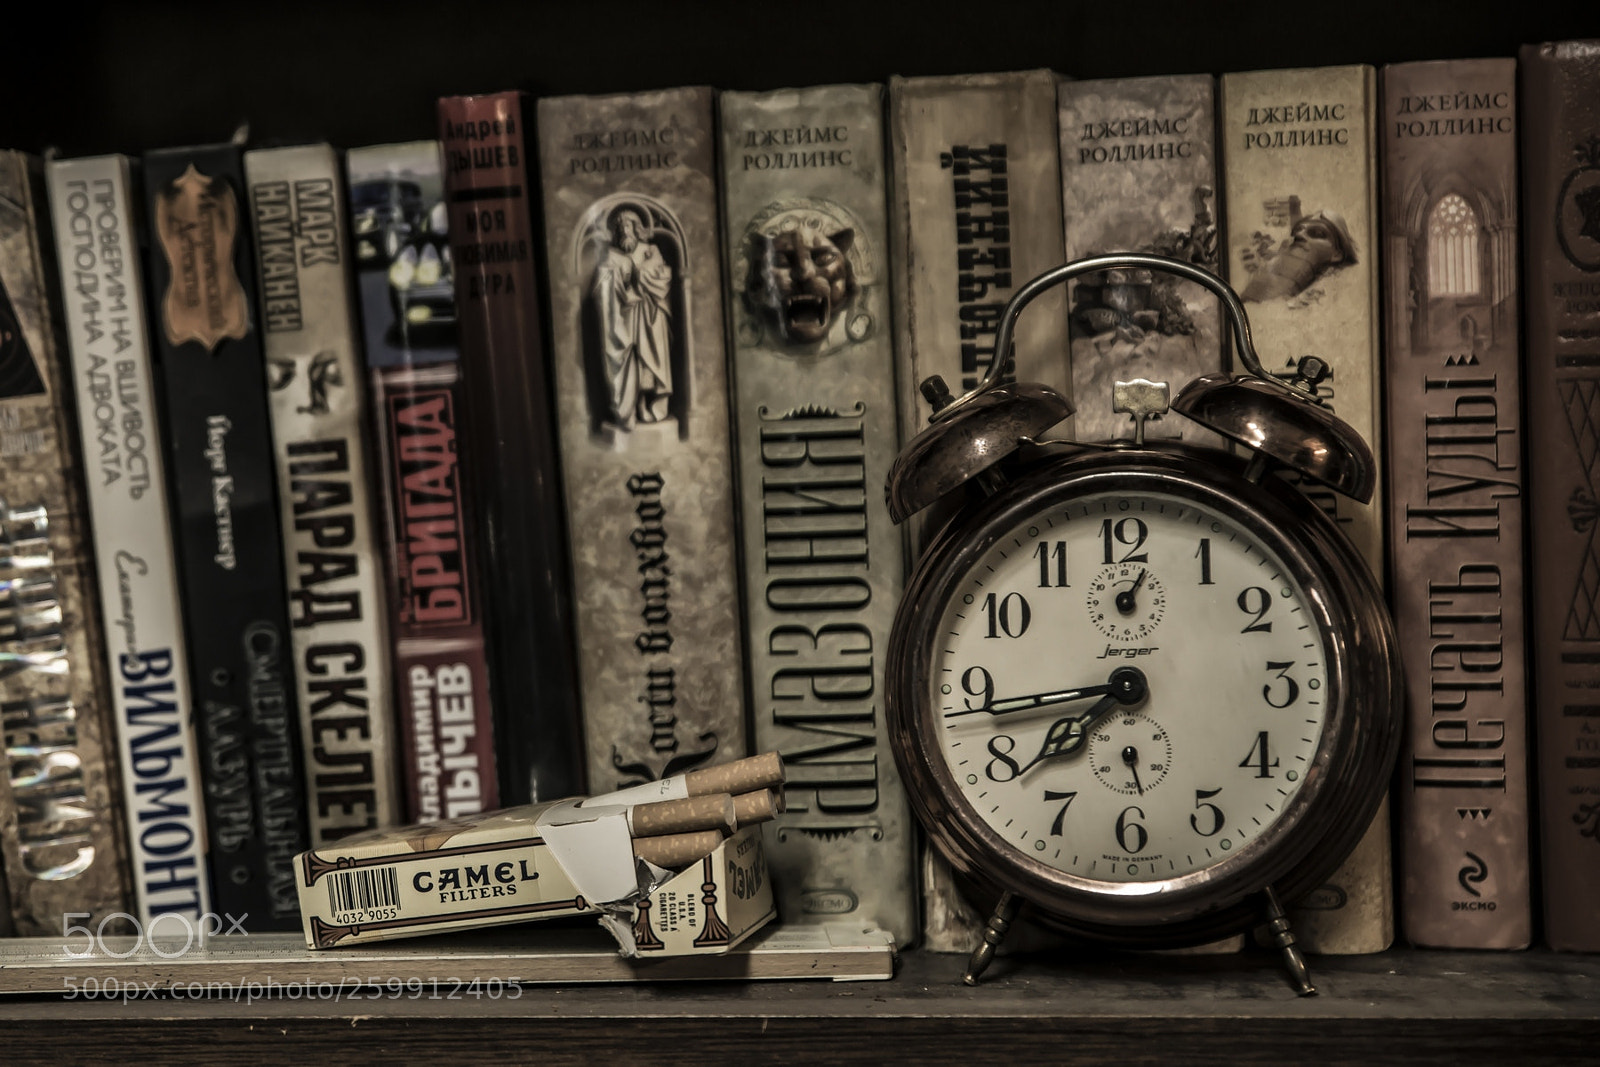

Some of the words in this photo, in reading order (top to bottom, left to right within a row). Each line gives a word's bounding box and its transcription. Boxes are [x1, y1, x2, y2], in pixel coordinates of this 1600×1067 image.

[1246, 104, 1344, 126] ДЖЕЙМС
[1398, 93, 1509, 115] ДЖЕЙМС
[446, 116, 515, 142] Андрей
[573, 125, 674, 152] ДЖЕЙМС
[744, 125, 849, 149] ДЖЕЙМС
[1081, 119, 1188, 141] ДЖЕЙМС
[1244, 127, 1348, 150] РОЛЛИНС
[1396, 116, 1512, 138] РОЛЛИНС
[571, 152, 678, 175] РОЛЛИНС
[742, 149, 853, 171] РОЛЛИНС
[1079, 142, 1192, 163] РОЛЛИНС
[295, 179, 342, 268] МАРК
[95, 180, 129, 314] ПРОВЕРИМ
[253, 180, 303, 332] НАЙКАНЕН
[67, 180, 103, 345] ГОСПОДИНА
[87, 353, 123, 486] АДВОКАТА
[108, 317, 136, 353] НА
[117, 359, 150, 500] ВШИВОСТЬ
[205, 415, 233, 473] Йорг
[1406, 374, 1520, 543] Иуды
[213, 475, 238, 570] Кастнер
[397, 397, 463, 620] БРИГАДА
[287, 439, 360, 628] ПАРАД
[1098, 518, 1148, 564] 12
[1033, 542, 1070, 588] 11
[1195, 538, 1215, 585] 1
[981, 592, 1031, 638] 10
[1237, 587, 1272, 633] 2
[1096, 643, 1160, 659] jerger
[962, 666, 994, 711] 9
[1263, 661, 1298, 707] 3
[1413, 564, 1506, 792] Печать
[1097, 734, 1111, 742] 50
[1123, 718, 1136, 726] 60
[1152, 733, 1162, 741] 10
[985, 736, 1019, 782] 8
[1099, 765, 1111, 773] 40
[1150, 763, 1163, 772] 20
[1239, 731, 1279, 778] 4
[120, 649, 200, 919] ВИЛЬМОНТ
[1125, 781, 1137, 789] 30
[1044, 790, 1077, 836] 7
[1191, 789, 1223, 836] 5
[1116, 806, 1148, 854] 6
[1102, 854, 1120, 862] MADE
[1131, 854, 1163, 862] GERMANY
[413, 860, 540, 893] CAMEL
[439, 884, 517, 903] FILTERS
[669, 892, 676, 901] 20
[687, 894, 696, 916] BLEND
[1451, 901, 1497, 912] ЭКСМО
[336, 911, 364, 924] 4032
[368, 908, 397, 920] 9055
[659, 892, 669, 932] CIGARETTES
[669, 903, 677, 926] CLASS
[689, 918, 696, 927] OF
